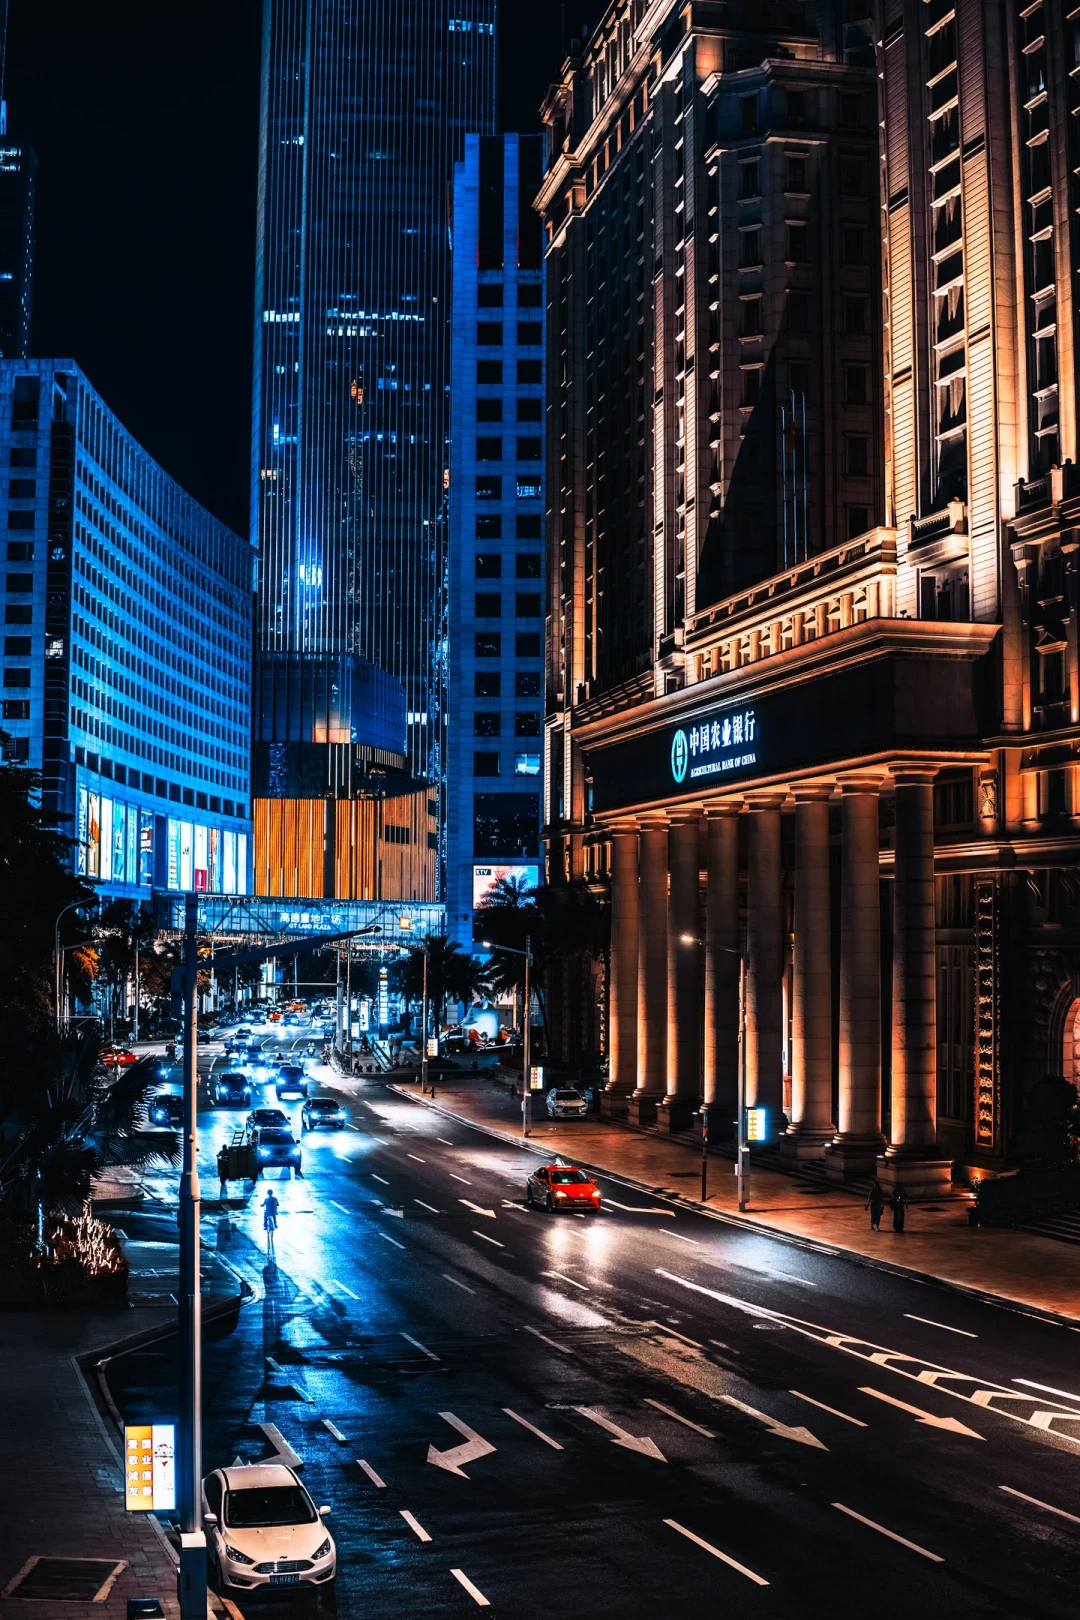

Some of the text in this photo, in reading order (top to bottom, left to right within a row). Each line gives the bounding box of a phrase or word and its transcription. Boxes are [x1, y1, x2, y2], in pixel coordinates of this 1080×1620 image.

[689, 710, 756, 757] 中国农业银行
[690, 753, 756, 778] AGRICULTURAL BANK OF CHINA
